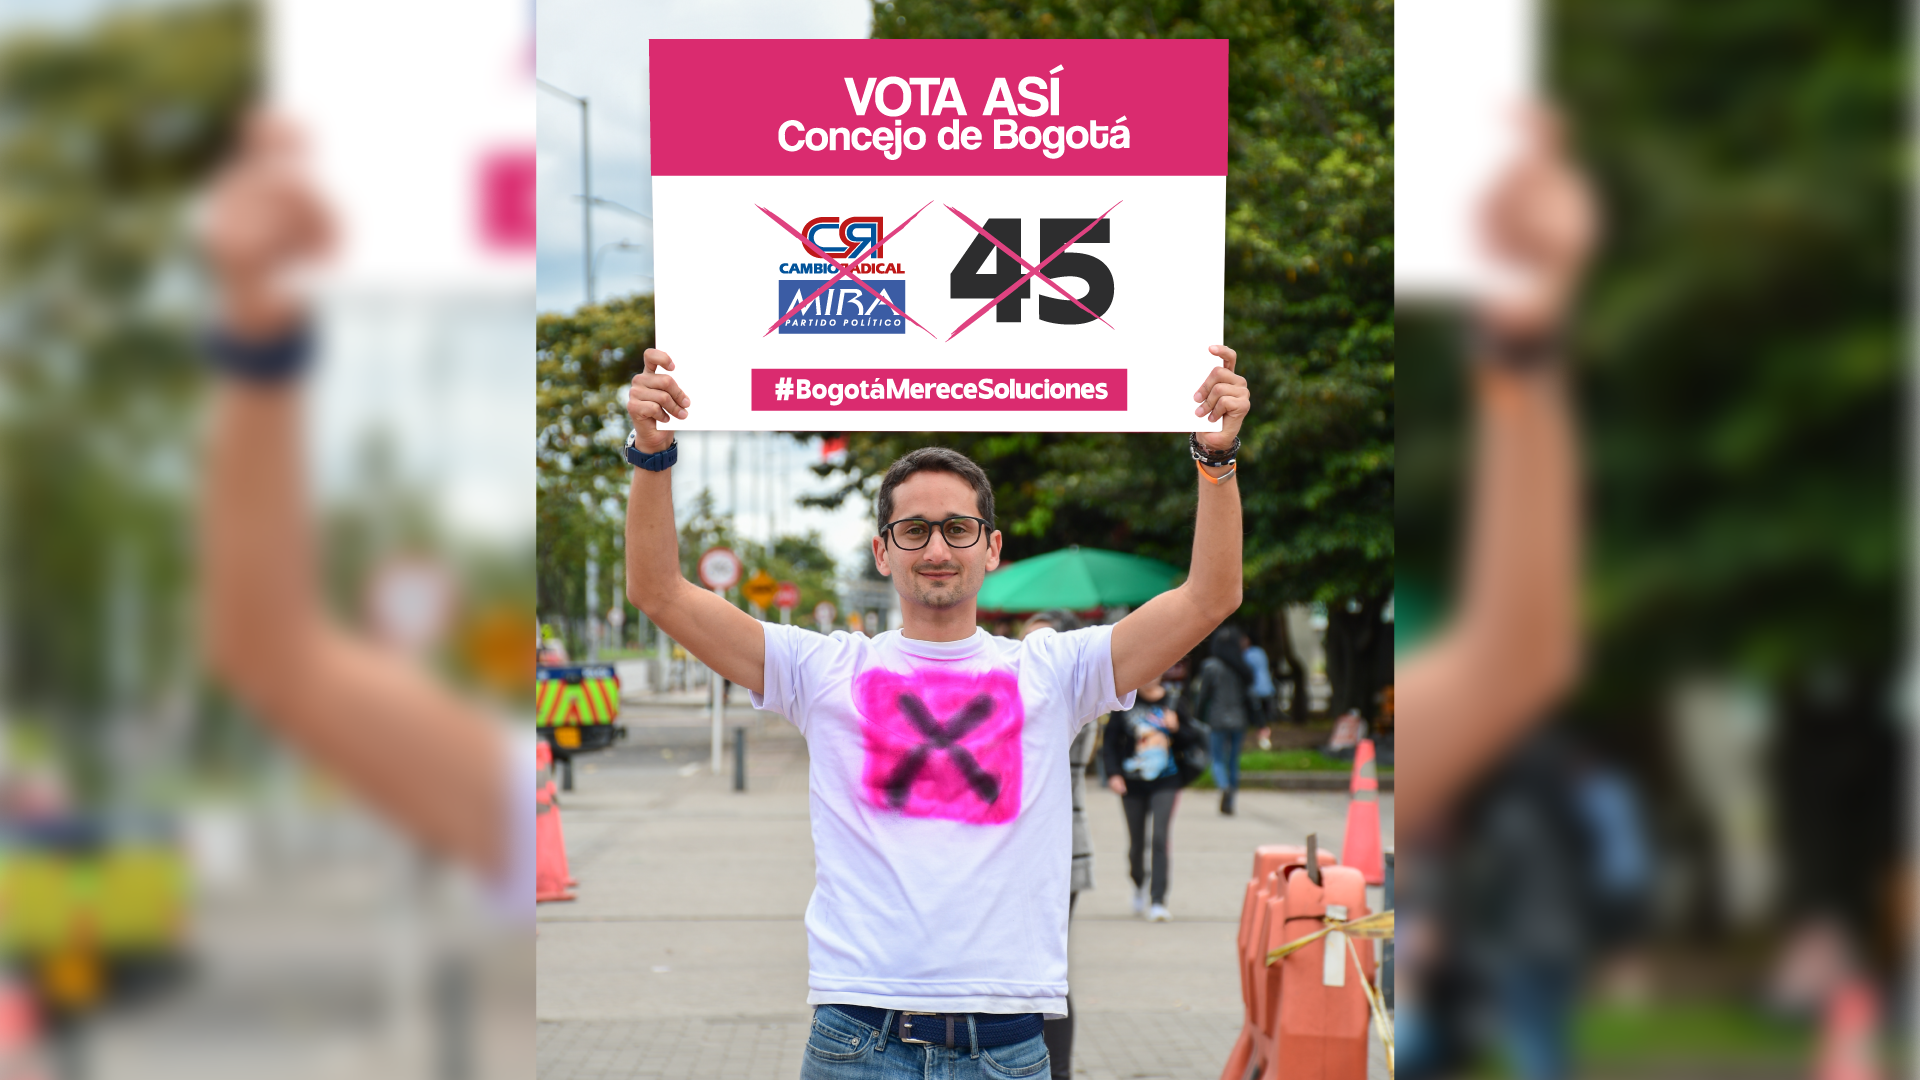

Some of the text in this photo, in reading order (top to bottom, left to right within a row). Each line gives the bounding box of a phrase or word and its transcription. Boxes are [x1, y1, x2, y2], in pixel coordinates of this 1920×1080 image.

[844, 64, 1065, 117] VOTA ASÍ
[778, 115, 1131, 161] Concejo de Bogotá
[779, 262, 906, 275] CAMBIOADICAL
[950, 218, 1115, 325] 45
[785, 287, 901, 316] MIRA
[784, 317, 902, 327] PARTIDO POLÍTICO
[774, 377, 1109, 407] #BogotáMereceSoluciones
